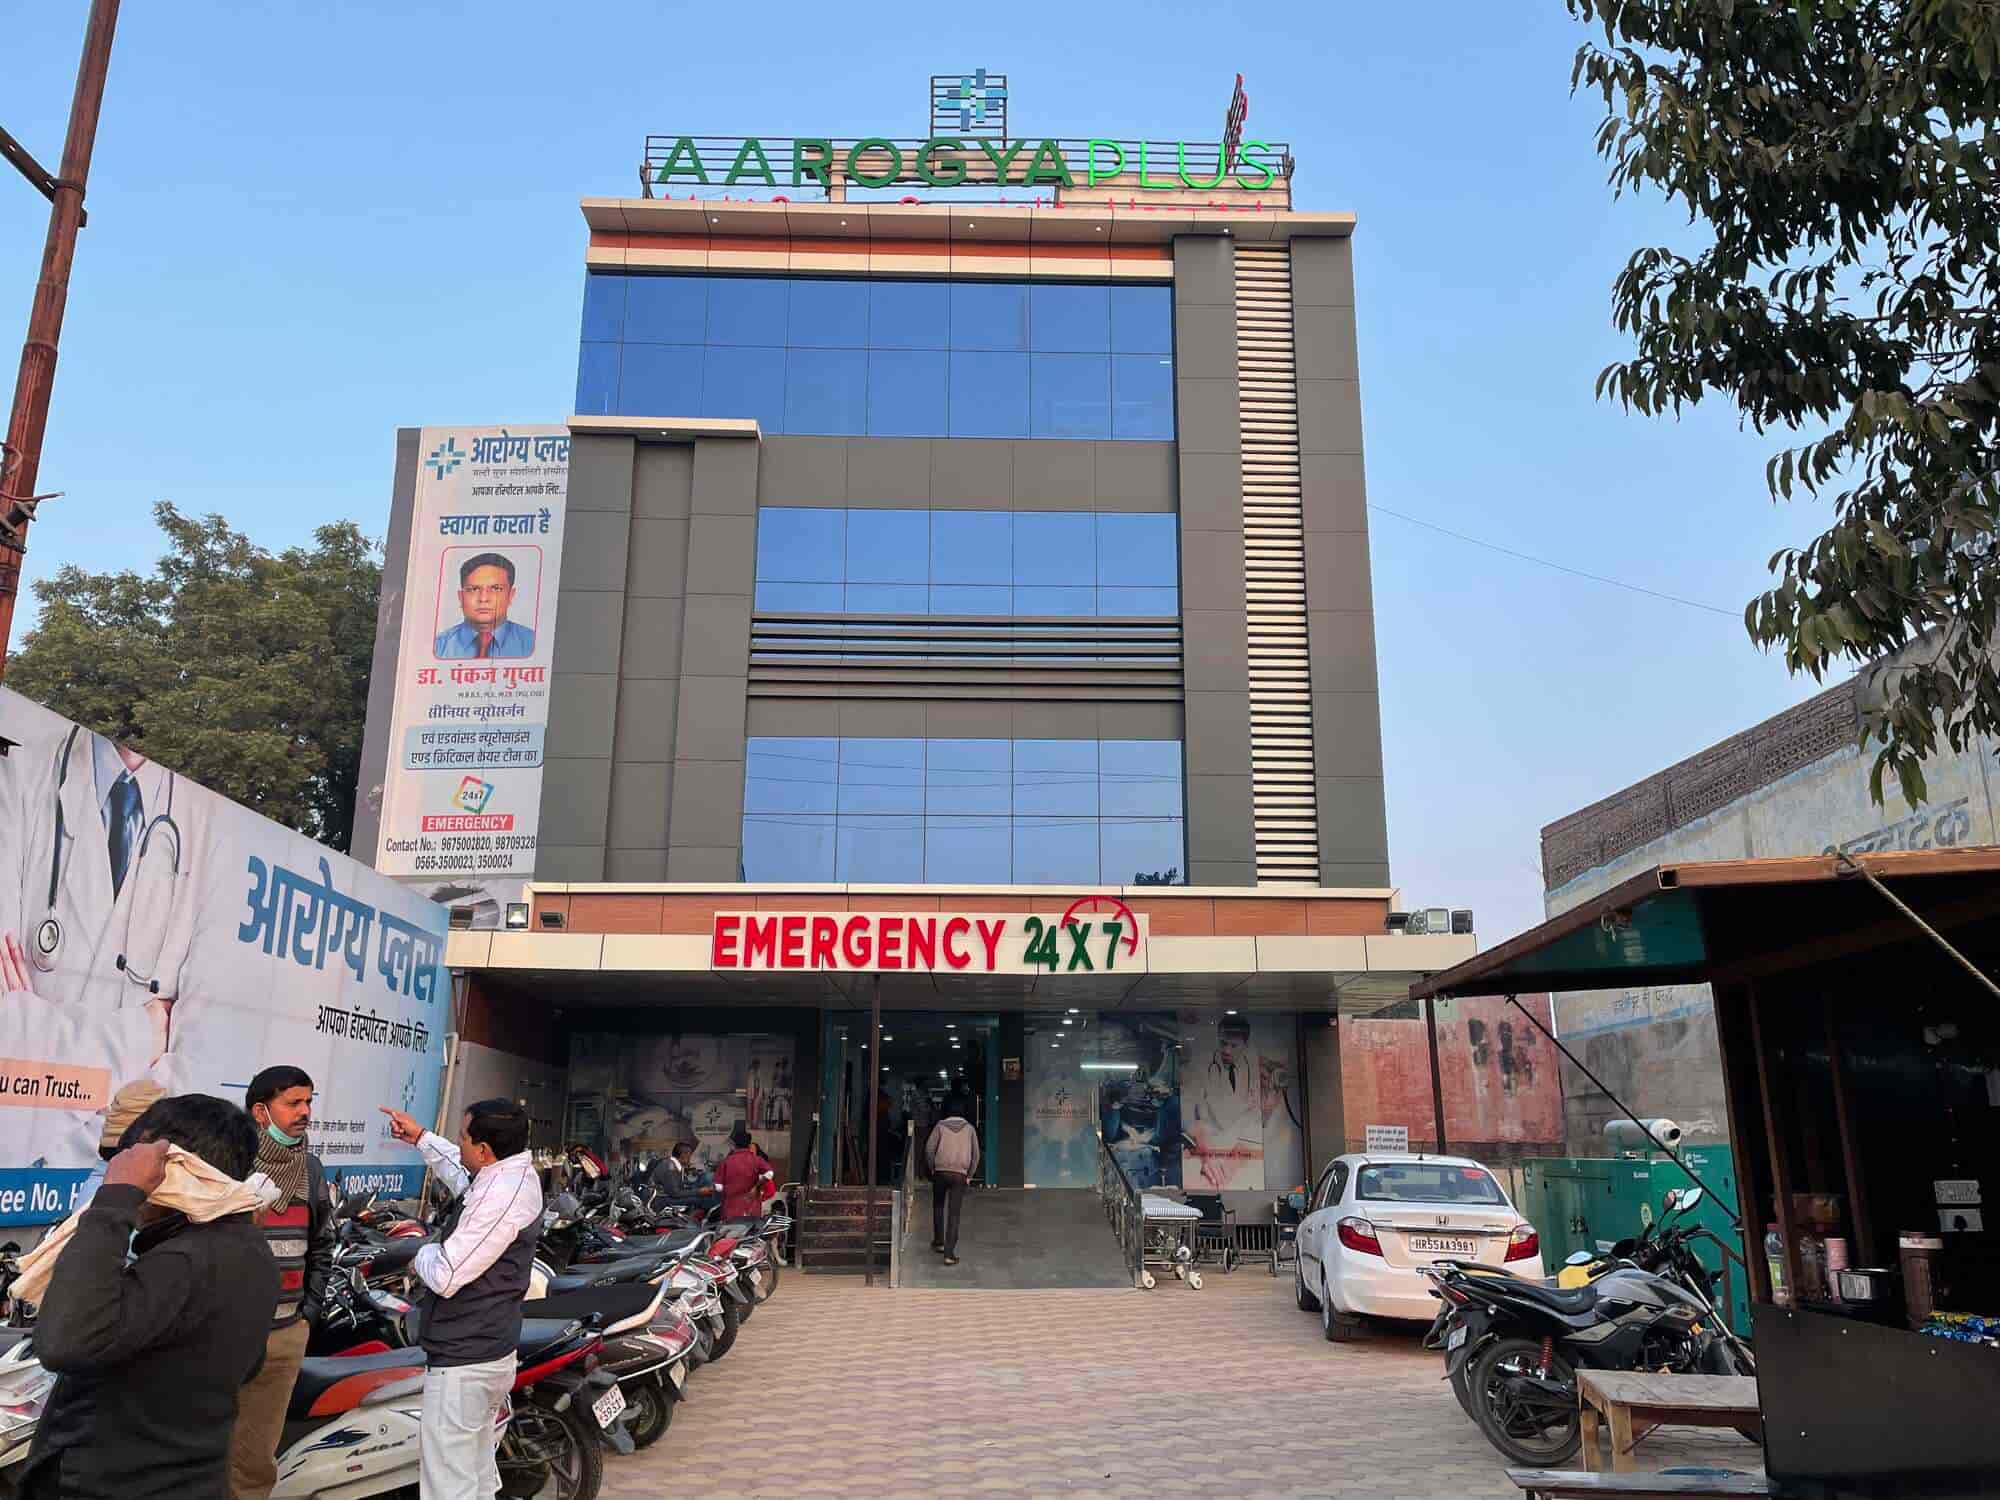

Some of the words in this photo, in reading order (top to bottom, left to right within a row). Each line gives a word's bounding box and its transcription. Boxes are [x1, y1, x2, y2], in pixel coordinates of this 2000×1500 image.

[471, 428, 531, 463] आरोग्य
[440, 515, 489, 535] स्वागत
[492, 514, 536, 534] करता
[537, 507, 551, 534] है
[450, 663, 499, 684] पंकज
[501, 666, 546, 689] गुप्ता
[429, 704, 470, 719] सीनियर
[472, 703, 525, 721] न्यूरोसर्जन
[411, 751, 432, 764] एण्ड
[476, 748, 501, 762] केयर
[503, 747, 522, 762] टीम
[524, 750, 538, 761] का
[427, 816, 508, 830] EMERGENCY
[386, 838, 417, 852] Contact
[477, 854, 513, 869] 3500024
[238, 855, 377, 984] आरोग्य
[377, 911, 444, 1004] प्लस
[713, 915, 1007, 971] EMERGENCY
[315, 1004, 350, 1038] आपका
[350, 1004, 389, 1046] हॉस्पीटल
[388, 1017, 413, 1049] आपके
[412, 1020, 430, 1054] लिए
[13, 1075, 40, 1097] can
[45, 1074, 92, 1100] Trust...
[30, 1182, 63, 1212] No.
